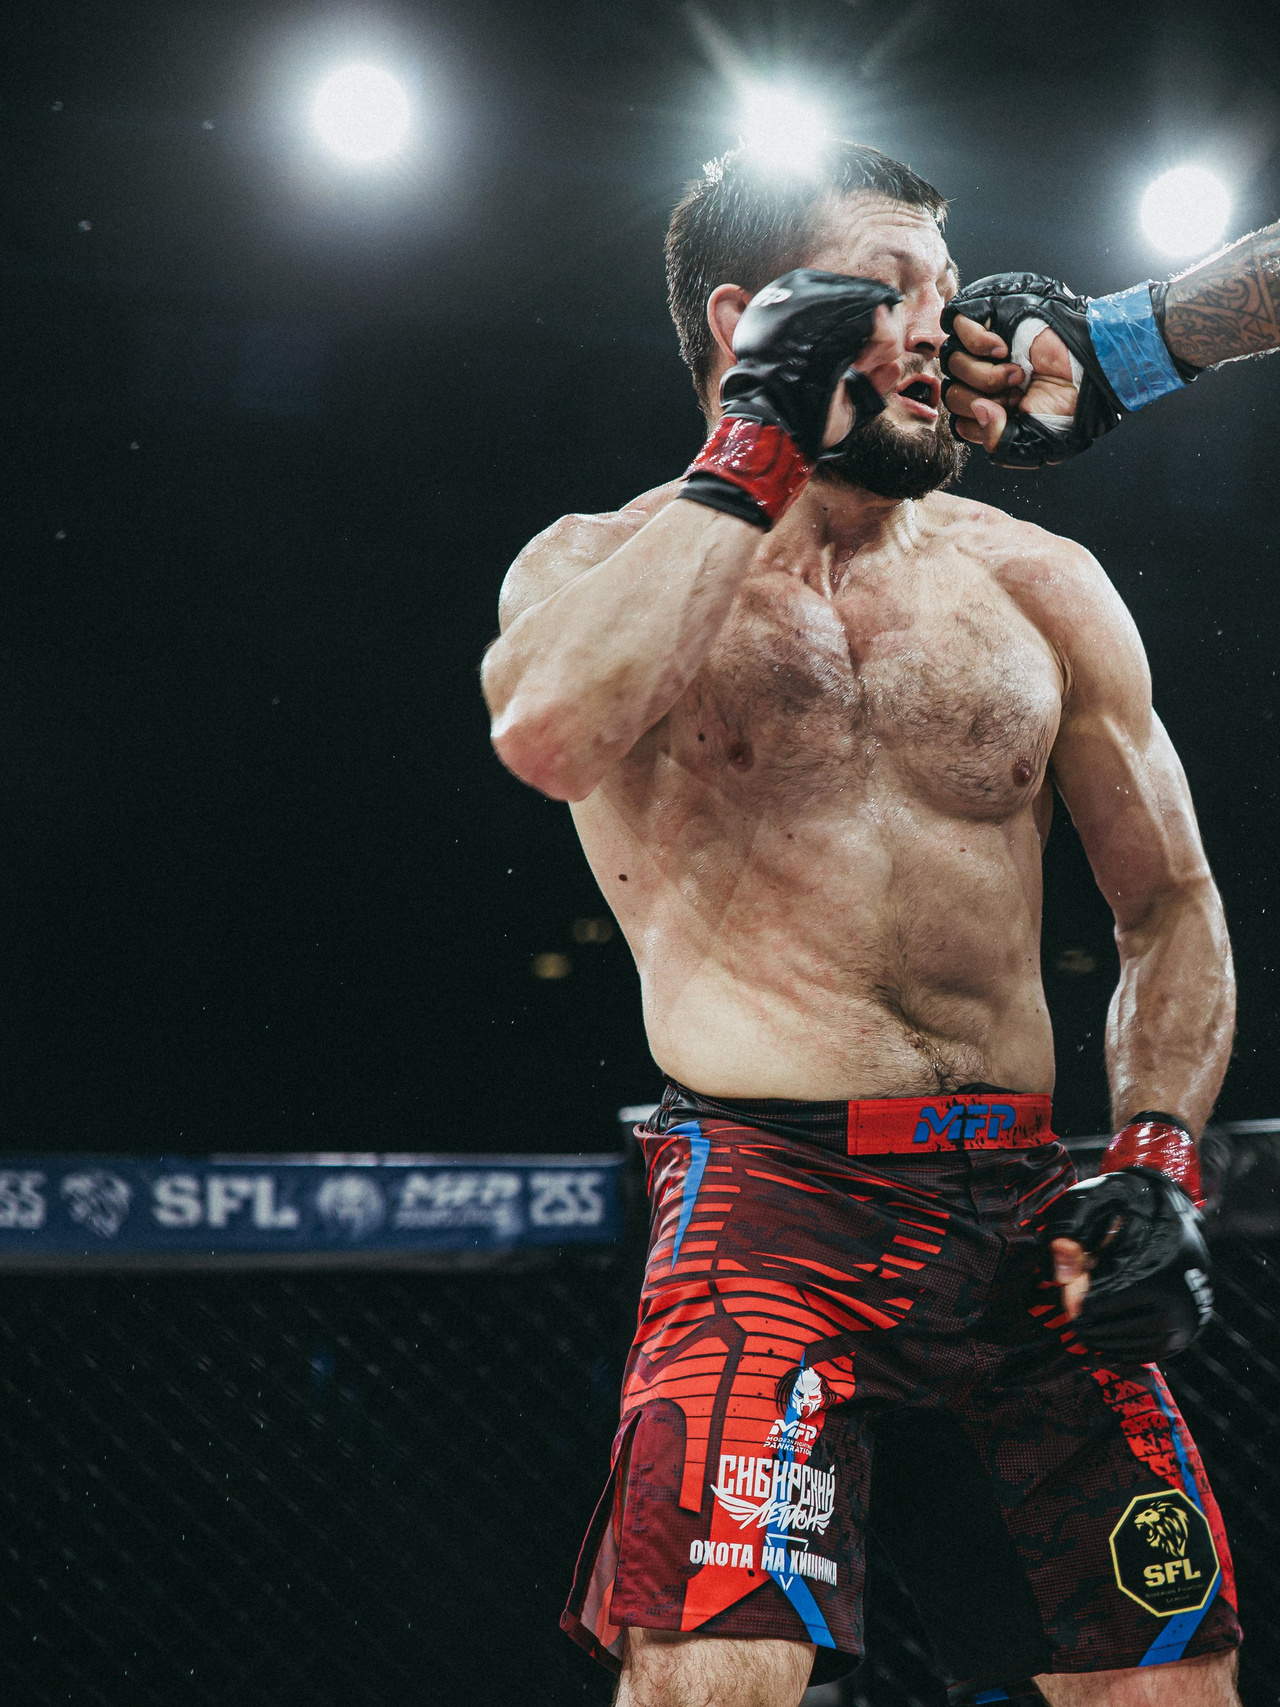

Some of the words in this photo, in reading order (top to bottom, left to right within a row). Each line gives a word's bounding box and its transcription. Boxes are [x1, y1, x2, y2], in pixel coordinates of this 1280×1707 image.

[913, 1104, 1016, 1143] MFP
[153, 1174, 298, 1229] SFL
[763, 1441, 812, 1456] PANKRATION
[769, 1419, 817, 1442] MFP
[718, 1454, 836, 1512] СИБИРСКИЙ
[690, 1539, 753, 1569] ОХОТА
[761, 1546, 785, 1572] НА
[789, 1550, 837, 1586] ХИЩНИКА
[1143, 1558, 1201, 1588] SFL
